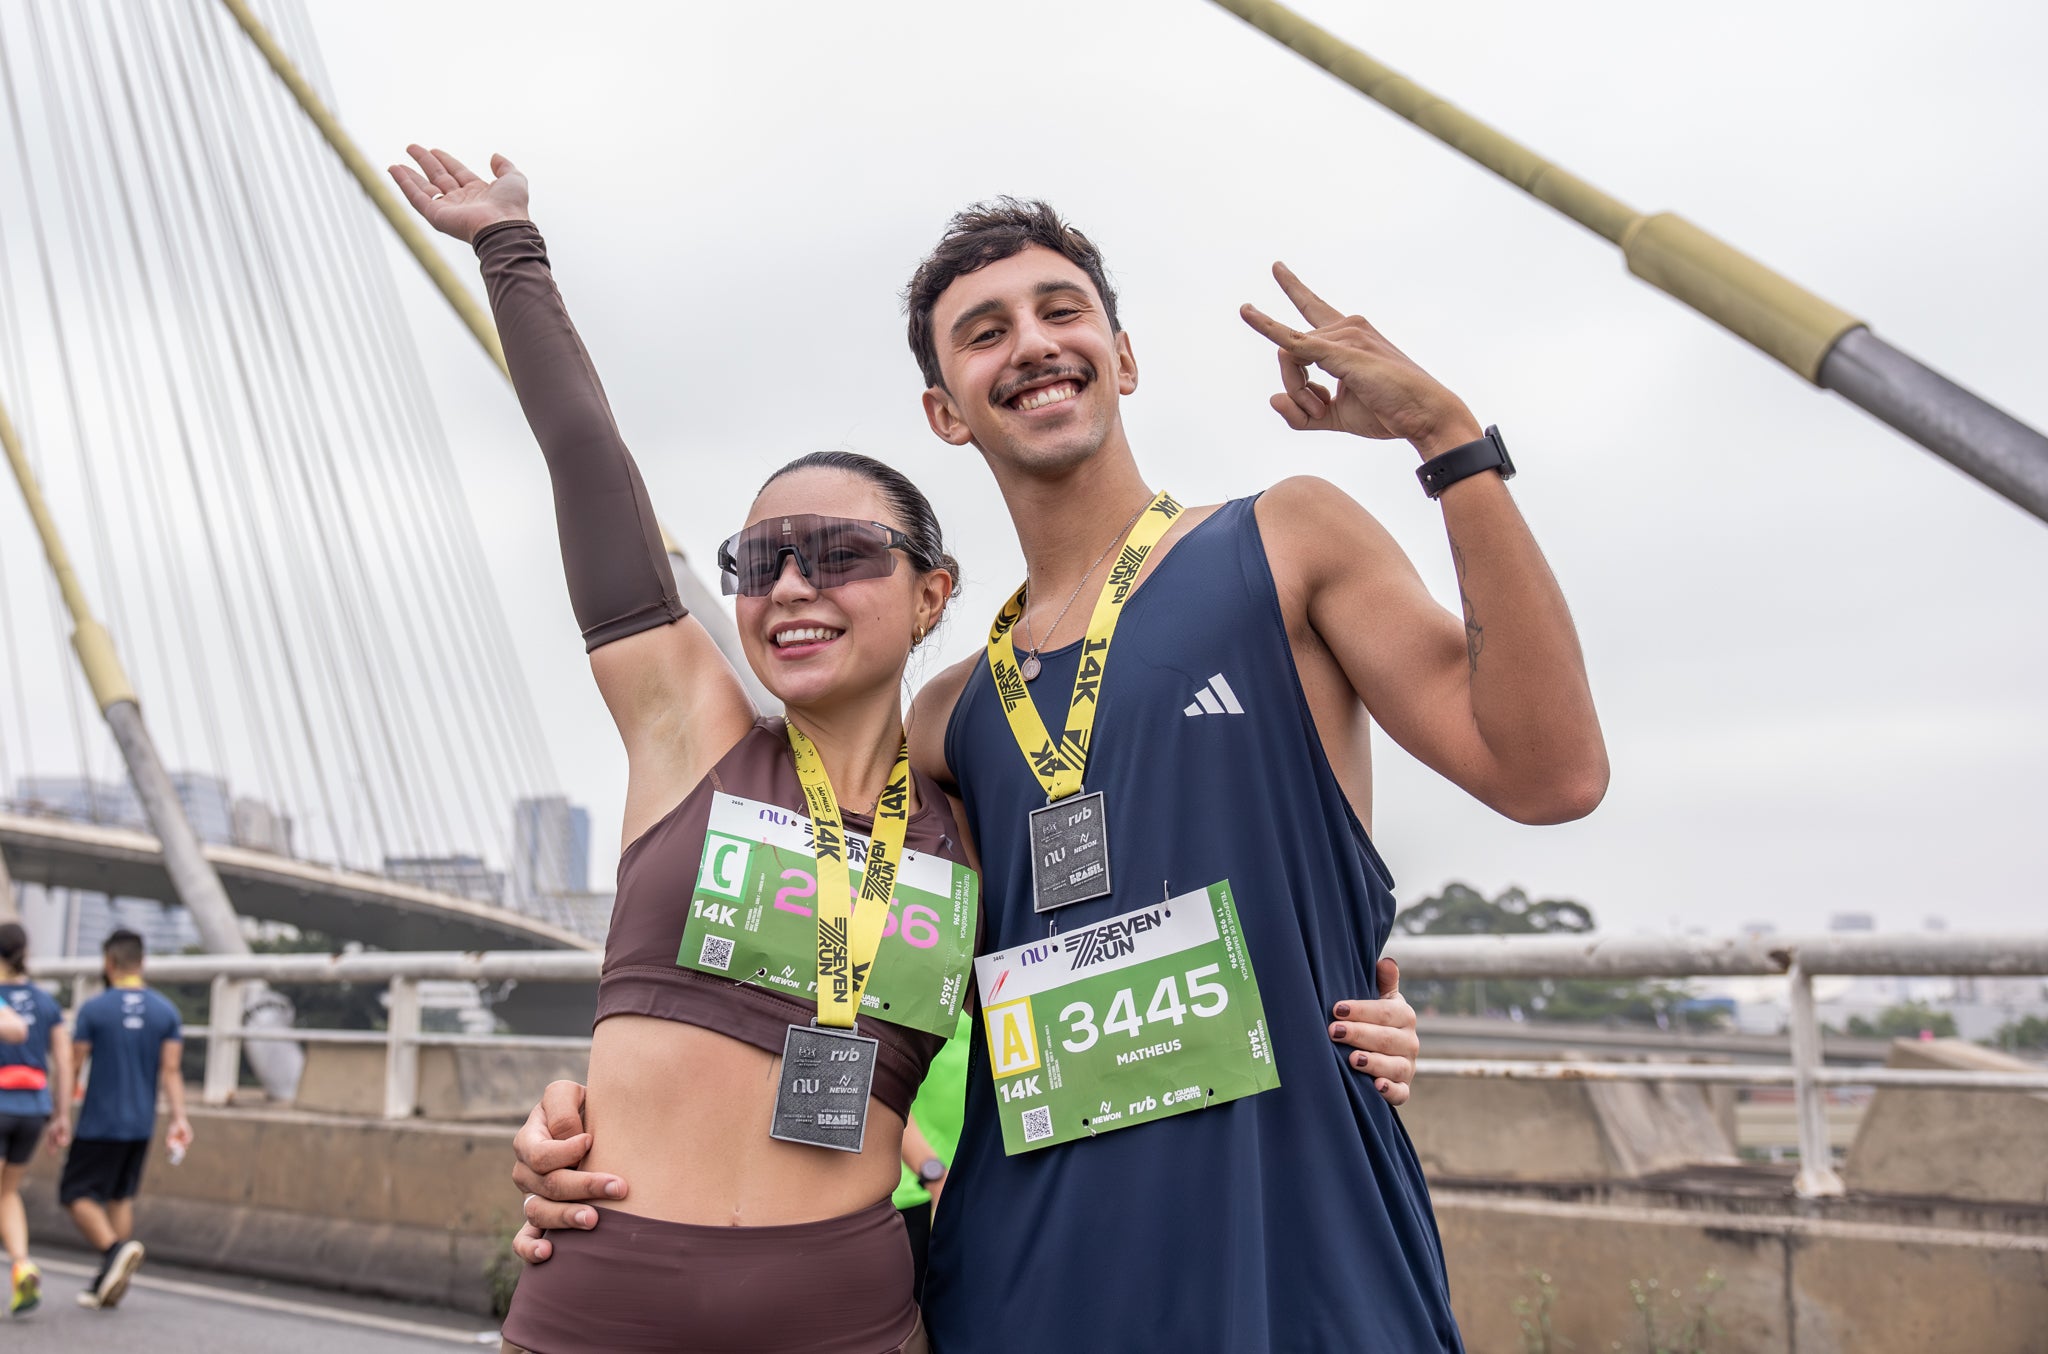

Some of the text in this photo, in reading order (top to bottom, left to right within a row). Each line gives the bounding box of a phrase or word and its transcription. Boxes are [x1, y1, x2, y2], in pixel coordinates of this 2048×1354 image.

[1108, 556, 1130, 585] RUN
[1112, 563, 1141, 604] SEVEN
[993, 659, 1011, 695] SEVEN
[1007, 665, 1023, 690] RUN
[1072, 638, 1107, 708] 14K
[1030, 739, 1058, 790] 4K
[880, 775, 907, 820] 14K
[759, 809, 788, 826] nu
[1068, 806, 1092, 827] rvb
[815, 816, 842, 862] 14K
[1073, 839, 1097, 854] NEWON
[713, 843, 739, 889] C
[867, 840, 887, 880] SEVEN
[1044, 846, 1066, 868] nu
[880, 860, 896, 891] RUN
[694, 899, 739, 928] 14K
[773, 868, 941, 949] 26
[1095, 910, 1162, 945] SEVEN
[1216, 907, 1238, 969] 11 955 006 296
[1220, 890, 1249, 981] TELEFONE DE EMERGÊNCIA
[818, 935, 833, 976] RUN
[1021, 944, 1048, 967] nu
[1090, 936, 1135, 965] RUN
[769, 975, 800, 988] NEWON
[833, 945, 848, 1003] SEVEN
[940, 977, 954, 1006] 2656
[1058, 963, 1229, 1053] 3445
[1002, 1011, 1030, 1067] A
[1116, 1038, 1182, 1067] MATHEUS
[1248, 1029, 1263, 1059] 3445
[830, 1047, 860, 1062] rvb
[792, 1078, 820, 1094] nu
[1000, 1075, 1042, 1103] 14K
[1174, 1085, 1201, 1097] IGUANA
[1175, 1091, 1202, 1103] SPORTS
[817, 1113, 859, 1126] BRASIL
[1092, 1111, 1122, 1125] NEWON
[1128, 1095, 1157, 1116] rvb
